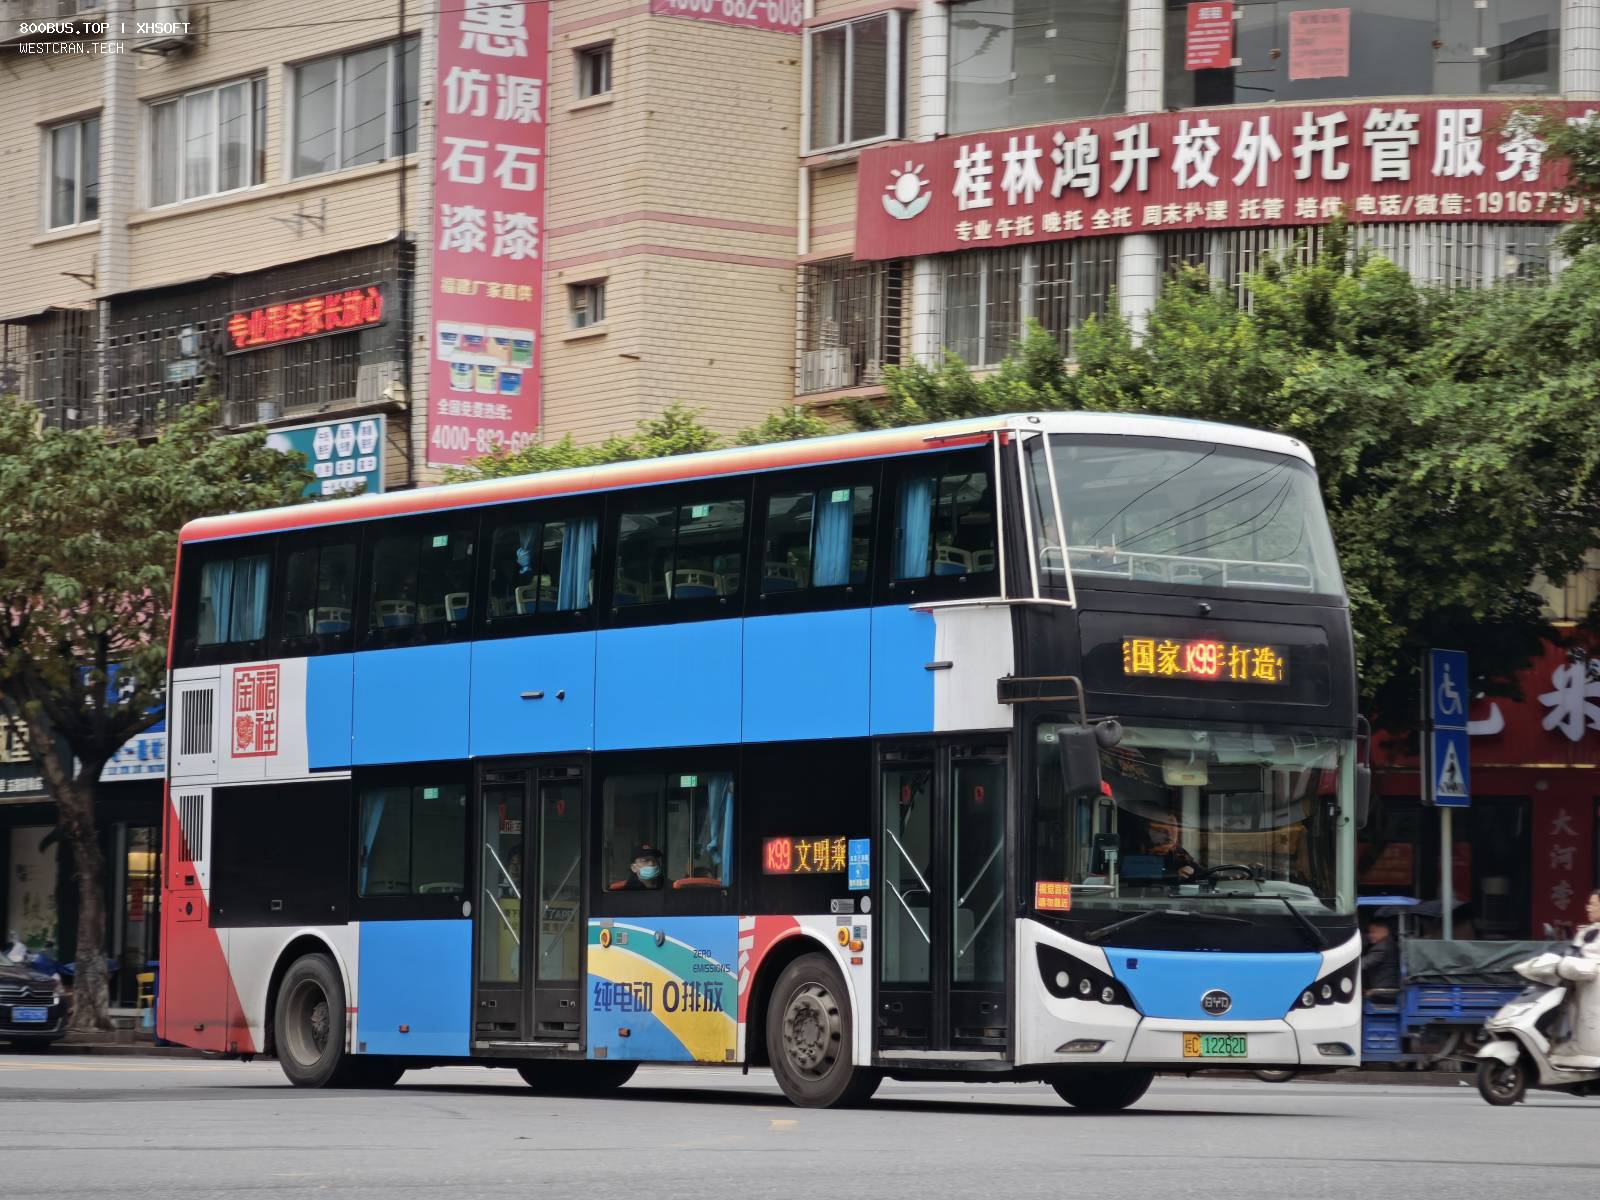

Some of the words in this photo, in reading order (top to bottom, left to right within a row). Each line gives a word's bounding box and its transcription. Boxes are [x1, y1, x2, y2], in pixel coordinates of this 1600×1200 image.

[955, 220, 992, 241] 专业
[996, 215, 1034, 239] 午托
[1041, 210, 1083, 233] 晚托
[1091, 206, 1132, 230] 全托
[1142, 200, 1228, 226] 周末补课
[1239, 197, 1284, 219] 托管
[227, 286, 384, 348] 专业服务家长放心
[1186, 643, 1218, 675] K99
[767, 839, 791, 871] K99
[692, 949, 713, 960] ZERO
[692, 963, 731, 974] EMISSIONS
[593, 981, 653, 1013] 纯电动
[1205, 997, 1229, 1008] BYD
